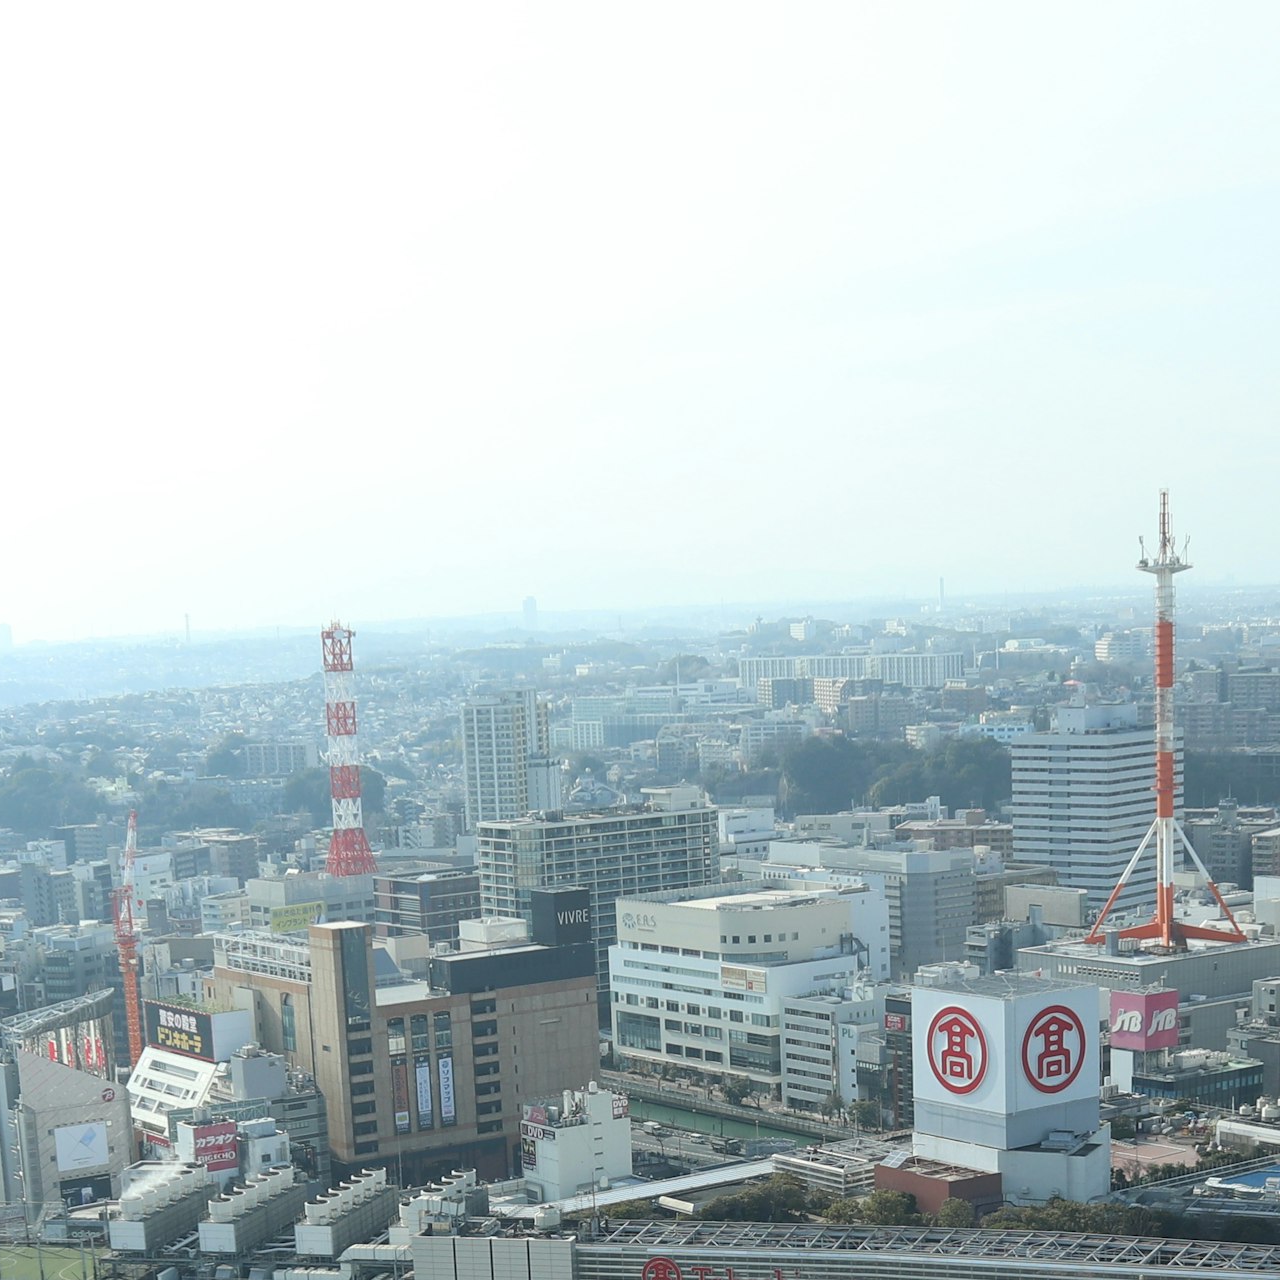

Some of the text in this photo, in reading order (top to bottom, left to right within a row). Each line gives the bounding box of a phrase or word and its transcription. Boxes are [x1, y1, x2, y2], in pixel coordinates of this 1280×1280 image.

[557, 908, 589, 925] VIVRE
[159, 1009, 198, 1033] 驚安の殿堂
[1112, 1008, 1142, 1032] JTB
[1147, 1008, 1176, 1036] JTB
[157, 1026, 202, 1053] ドンキホーテ
[842, 1027, 854, 1039] PL
[613, 1099, 629, 1108] DVD
[196, 1133, 235, 1148] カラオケ
[527, 1125, 544, 1139] DVD
